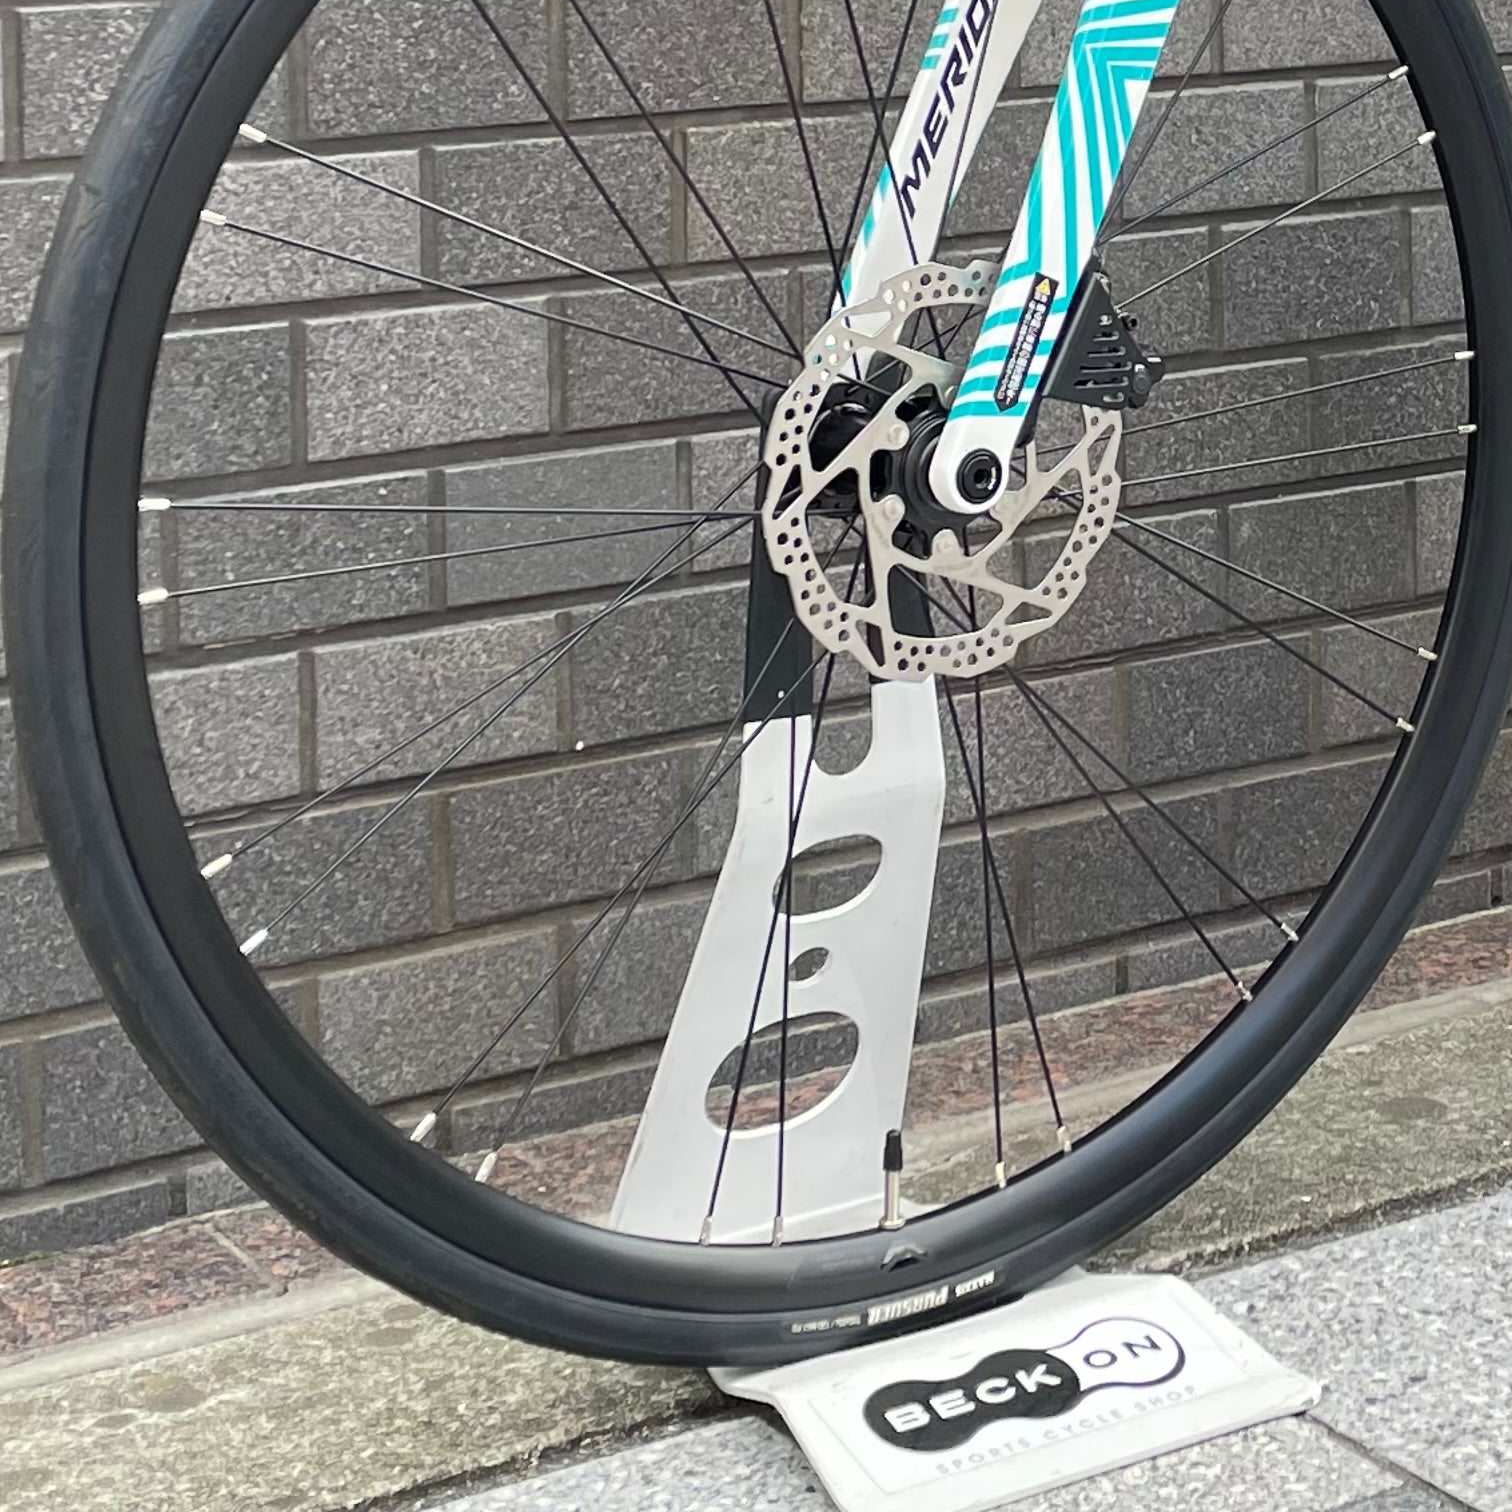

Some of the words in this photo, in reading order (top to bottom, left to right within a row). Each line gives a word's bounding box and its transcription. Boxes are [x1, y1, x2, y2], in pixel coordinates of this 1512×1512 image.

[867, 1284, 950, 1326] PURSUER
[935, 1437, 1032, 1475] SPORTS
[1042, 1407, 1124, 1441] CYCLE
[1133, 1384, 1196, 1413] SHOP
